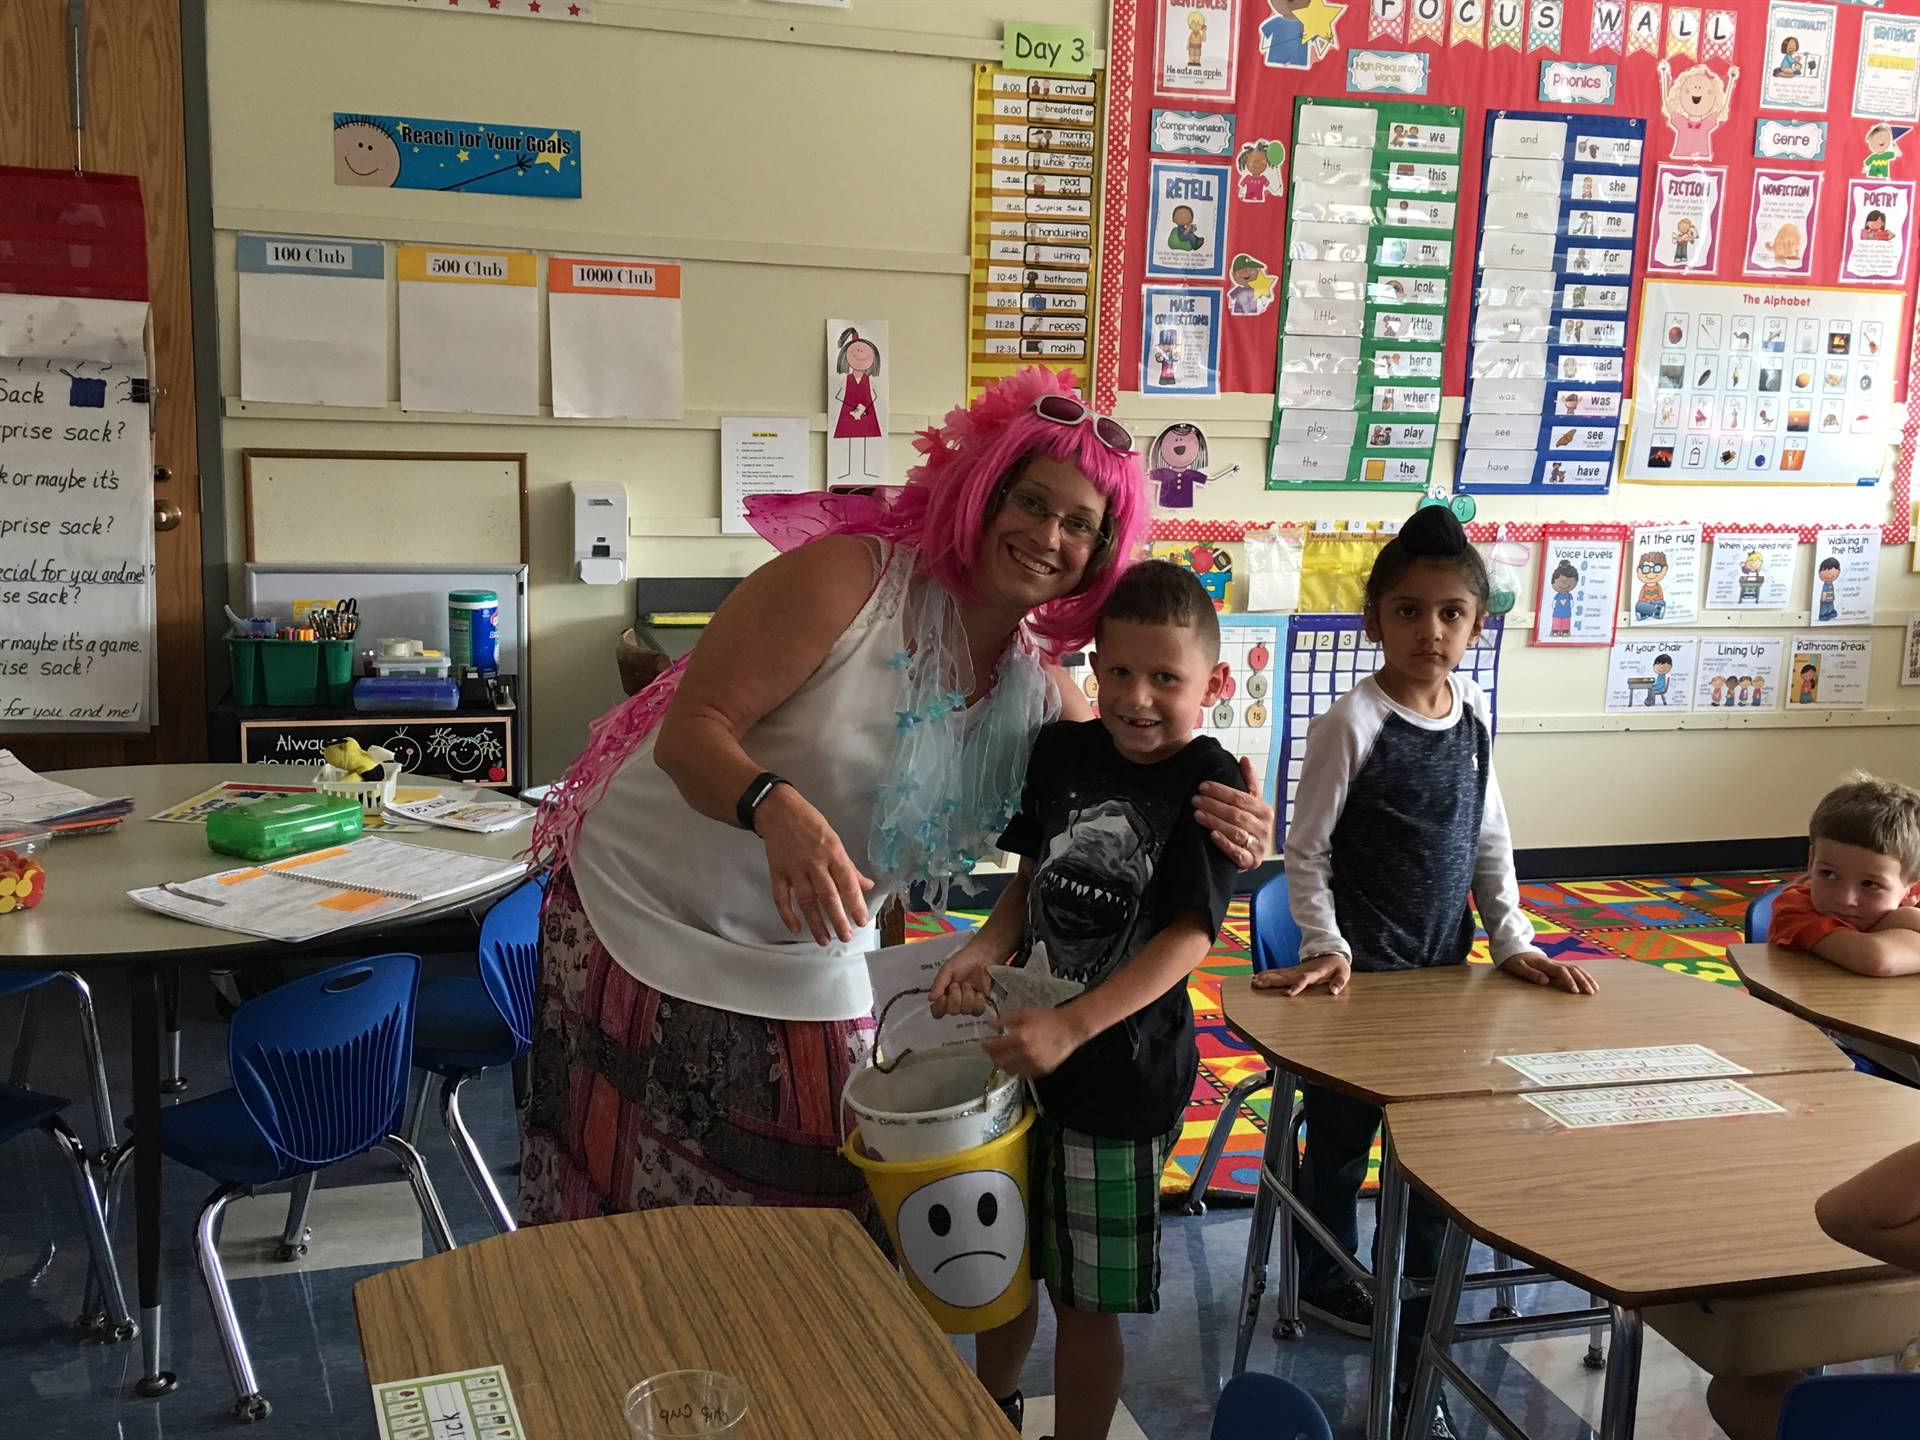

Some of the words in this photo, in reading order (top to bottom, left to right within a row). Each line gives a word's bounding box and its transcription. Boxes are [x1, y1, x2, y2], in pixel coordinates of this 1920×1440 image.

[1380, 0, 1554, 29] FOCUS
[1598, 8, 1725, 42] WALL
[1015, 32, 1061, 68] Day
[1071, 37, 1085, 63] 3
[1166, 65, 1176, 75] He
[1177, 67, 1193, 75] eats
[1193, 68, 1202, 76] an
[1551, 72, 1601, 90] Phonics
[1002, 83, 1021, 92] 8:00
[1055, 84, 1086, 96] arrival
[1003, 106, 1021, 115] 8:00
[1044, 103, 1083, 116] breakfast
[1085, 108, 1093, 116] or
[1160, 120, 1225, 134] Comprehension
[1330, 123, 1343, 132] we
[1429, 131, 1446, 143] we
[402, 126, 453, 147] Reach
[458, 129, 482, 148] for
[486, 133, 522, 152] Your
[526, 135, 572, 155] Goals
[1059, 130, 1091, 141] morning
[1172, 132, 1211, 144] Strategy
[1520, 133, 1538, 144] and
[1773, 133, 1810, 146] Genre
[1001, 156, 1020, 165] 8:45
[1043, 157, 1066, 167] whole
[1068, 159, 1092, 169] group
[1322, 159, 1341, 171] this
[1428, 167, 1447, 182] this
[1059, 176, 1080, 187] read
[1609, 179, 1626, 192] she
[1165, 178, 1214, 202] RETELL
[1762, 183, 1810, 198] NONFICTION
[1863, 191, 1898, 208] POETRY
[1429, 204, 1439, 218] is
[1515, 211, 1529, 219] me
[1607, 215, 1622, 226] me
[1038, 226, 1089, 239] handwriting
[272, 245, 301, 264] 100
[306, 245, 345, 266] Club
[1421, 243, 1438, 256] my
[1510, 245, 1525, 255] for
[1603, 250, 1621, 263] for
[1052, 251, 1081, 263] writing
[431, 257, 460, 275] 500
[464, 259, 503, 278] Club
[577, 266, 614, 284] 1000
[619, 267, 654, 286] Club
[997, 273, 1018, 282] 10:45
[1043, 274, 1084, 285] bathroom
[1318, 273, 1339, 285] look
[1414, 280, 1435, 293] look
[1599, 290, 1617, 301] are
[1742, 294, 1761, 305] The
[1763, 294, 1811, 307] Alphabet
[1051, 298, 1077, 309] lunch
[1170, 298, 1196, 314] MAKE
[1313, 310, 1336, 321] little
[994, 319, 1014, 329] 11:28
[1048, 321, 1080, 332] recess
[1594, 323, 1616, 337] with
[995, 345, 1016, 354] 12:36
[1050, 342, 1076, 354] math
[1310, 348, 1332, 360] here
[1409, 353, 1432, 366] here
[1593, 359, 1613, 371] said
[1302, 384, 1332, 397] where
[1403, 391, 1436, 403] where
[1498, 392, 1516, 401] was
[1591, 395, 1611, 406] was
[0, 422, 53, 443] prise
[63, 421, 126, 442] sack?
[1307, 424, 1329, 438] play
[1403, 426, 1425, 440] play
[1494, 429, 1511, 437] see
[1587, 429, 1604, 440] see
[1302, 456, 1318, 468] the
[1399, 461, 1416, 474] the
[1488, 460, 1509, 472] have
[1577, 464, 1600, 477] have
[13, 472, 33, 487] or
[35, 467, 88, 493] maybe
[93, 470, 120, 490] it's
[1457, 500, 1466, 517] 9
[0, 517, 51, 539] prise
[59, 515, 114, 537] sack?
[1640, 535, 1651, 546] At
[1655, 533, 1673, 545] the
[1676, 533, 1695, 546] rug
[1828, 536, 1860, 546] Walking
[1862, 536, 1870, 545] in
[1719, 542, 1741, 550] When
[1743, 543, 1757, 552] you
[1758, 542, 1776, 550] need
[1832, 545, 1846, 555] the
[1848, 545, 1864, 554] Hall
[1554, 549, 1581, 560] Voice
[1583, 550, 1614, 560] Levels
[41, 558, 67, 581] for
[70, 567, 98, 588] you
[27, 587, 82, 606] sack?
[1576, 590, 1585, 602] 2
[11, 631, 59, 656] maybe
[62, 631, 84, 652] it's
[86, 639, 95, 652] a
[98, 637, 142, 655] game.
[1320, 634, 1330, 647] 2
[1343, 633, 1352, 647] 3
[1797, 641, 1839, 651] Bathroom
[1840, 641, 1866, 652] Break
[1625, 644, 1634, 653] At
[1636, 645, 1656, 655] your
[1658, 643, 1682, 653] Chair
[1718, 645, 1748, 658] Lining
[1750, 645, 1765, 658] Up
[40, 655, 94, 677] sack?
[1254, 683, 1261, 693] 8
[3, 697, 31, 718] for
[33, 704, 62, 719] you
[70, 701, 102, 718] and
[106, 701, 138, 718] me!
[1218, 711, 1228, 722] 14
[1252, 711, 1262, 722] 15
[1614, 1094, 1702, 1109] Shaelyn
